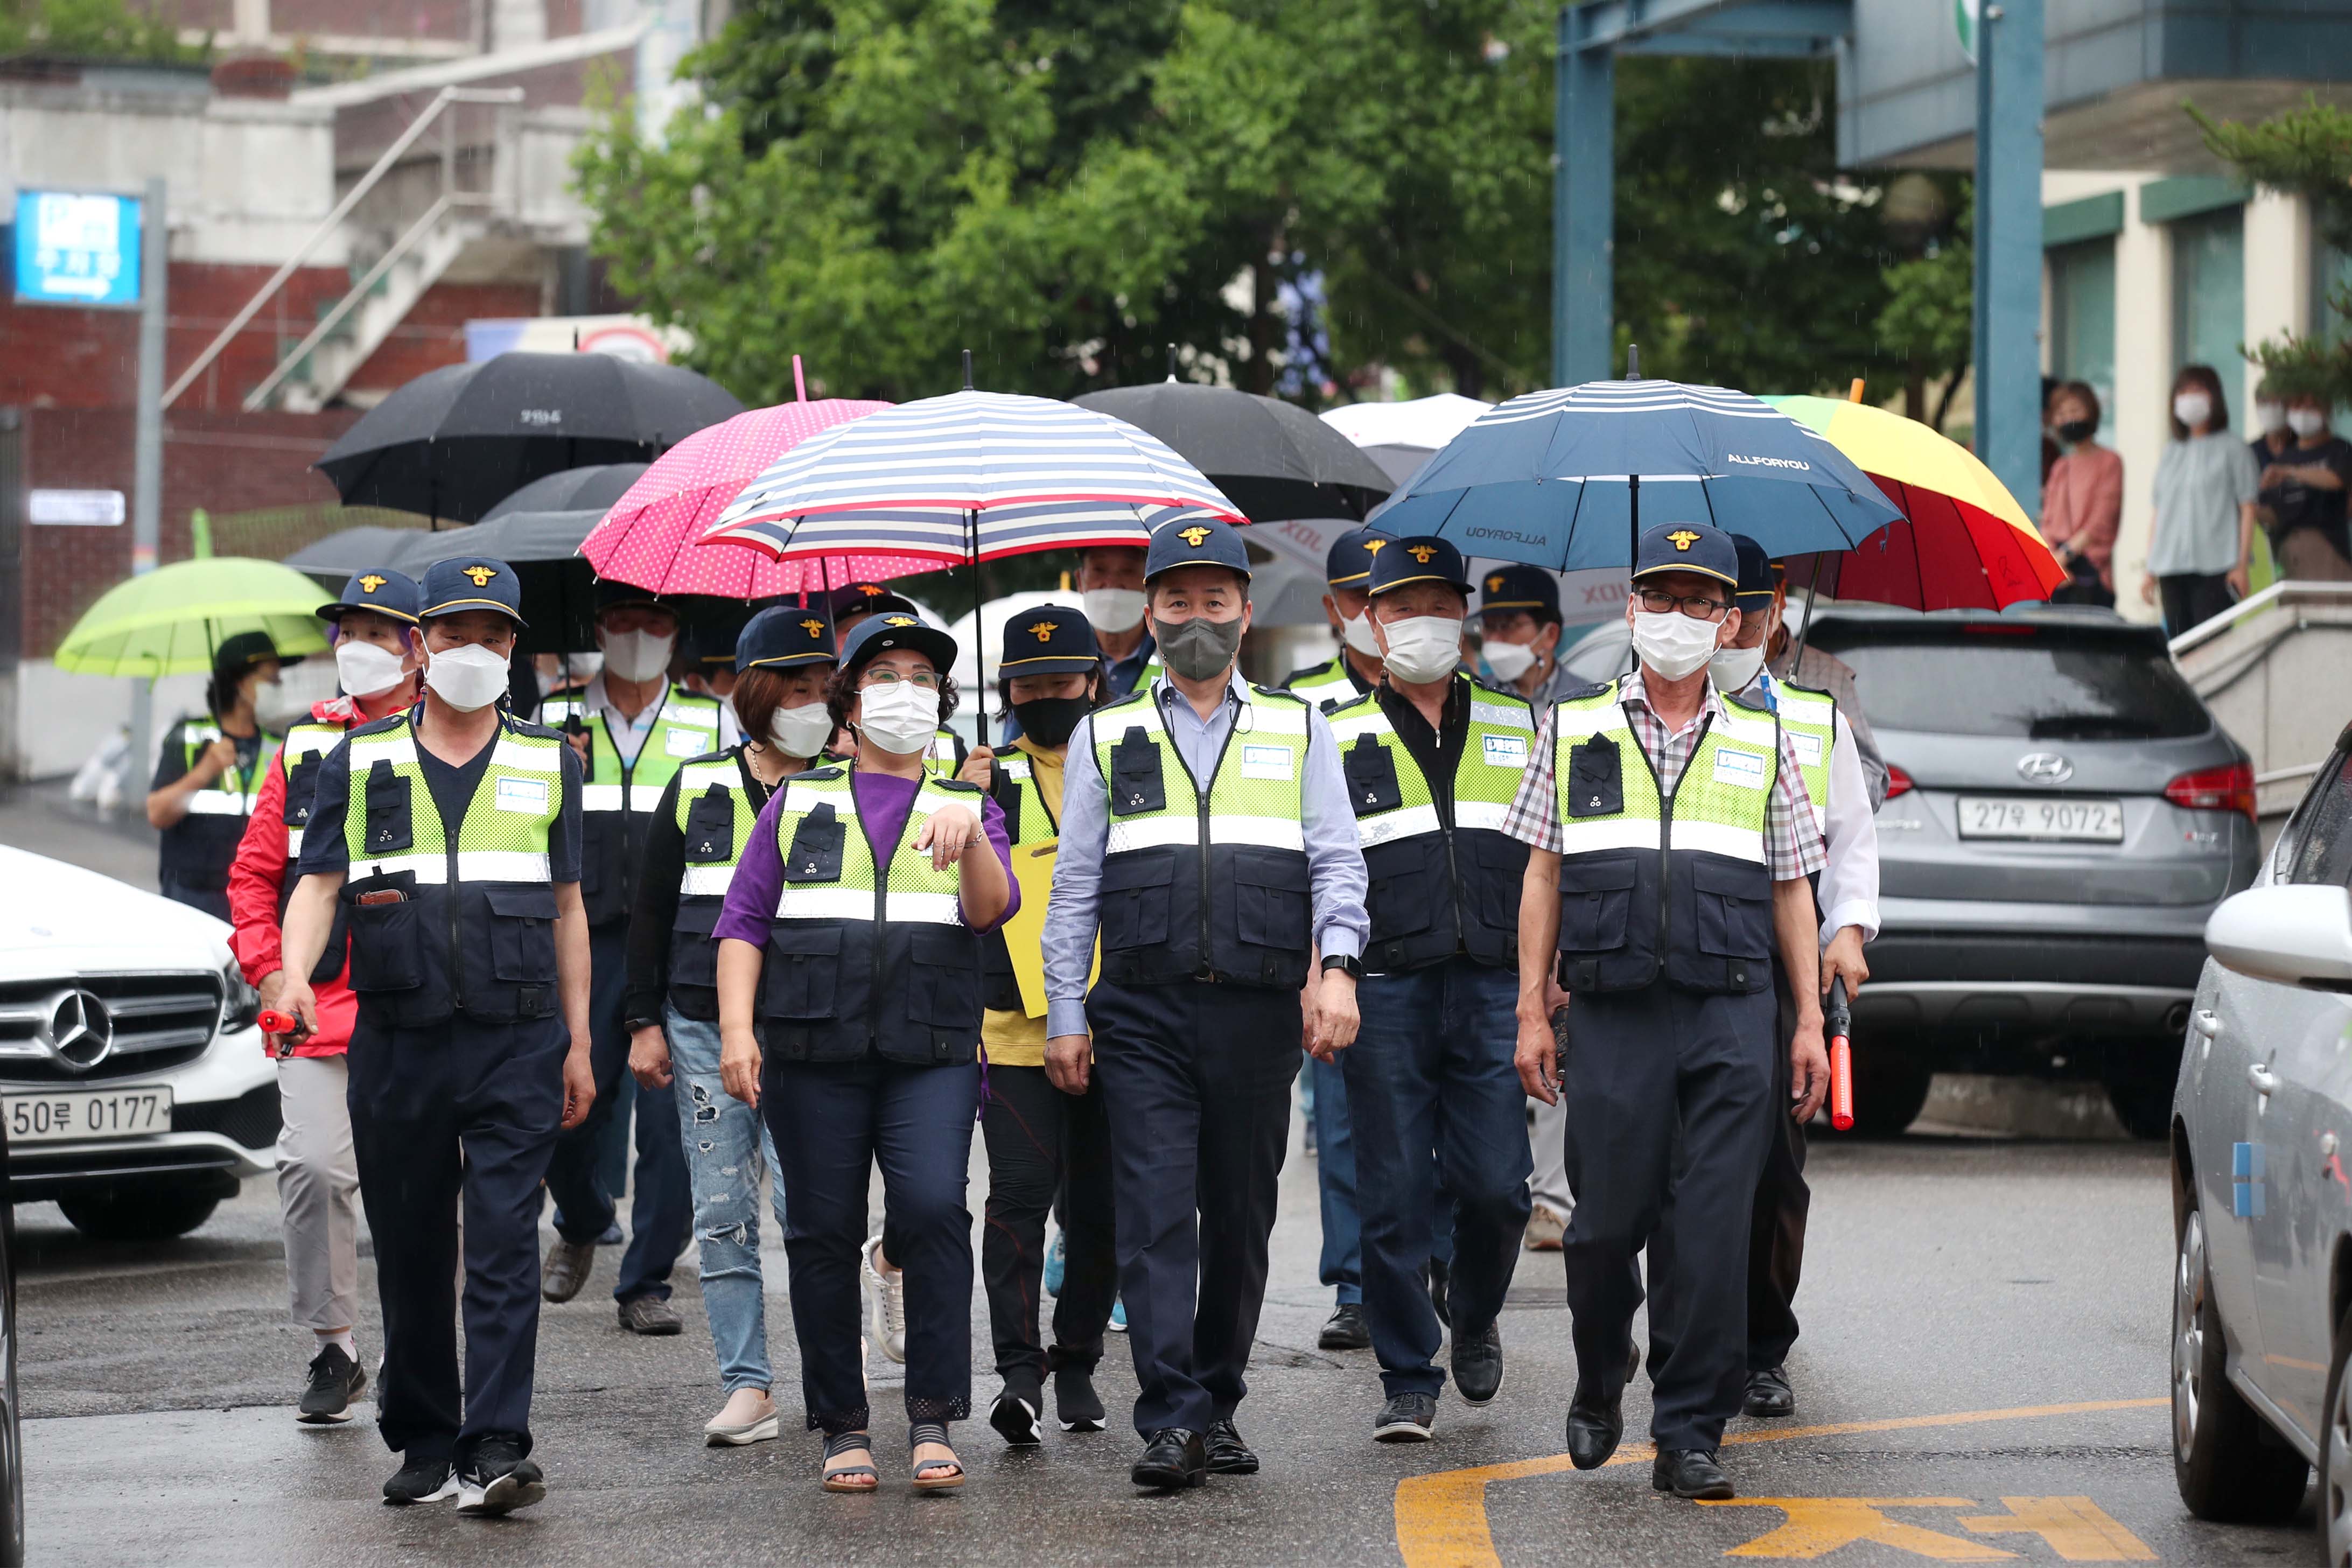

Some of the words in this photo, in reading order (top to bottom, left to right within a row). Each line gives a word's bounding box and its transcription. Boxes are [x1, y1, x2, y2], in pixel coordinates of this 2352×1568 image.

[1728, 453, 1810, 471] ALLFORYOU
[2040, 803, 2108, 831] 9072
[13, 1101, 71, 1134] 50루
[88, 1095, 157, 1130] 0177
